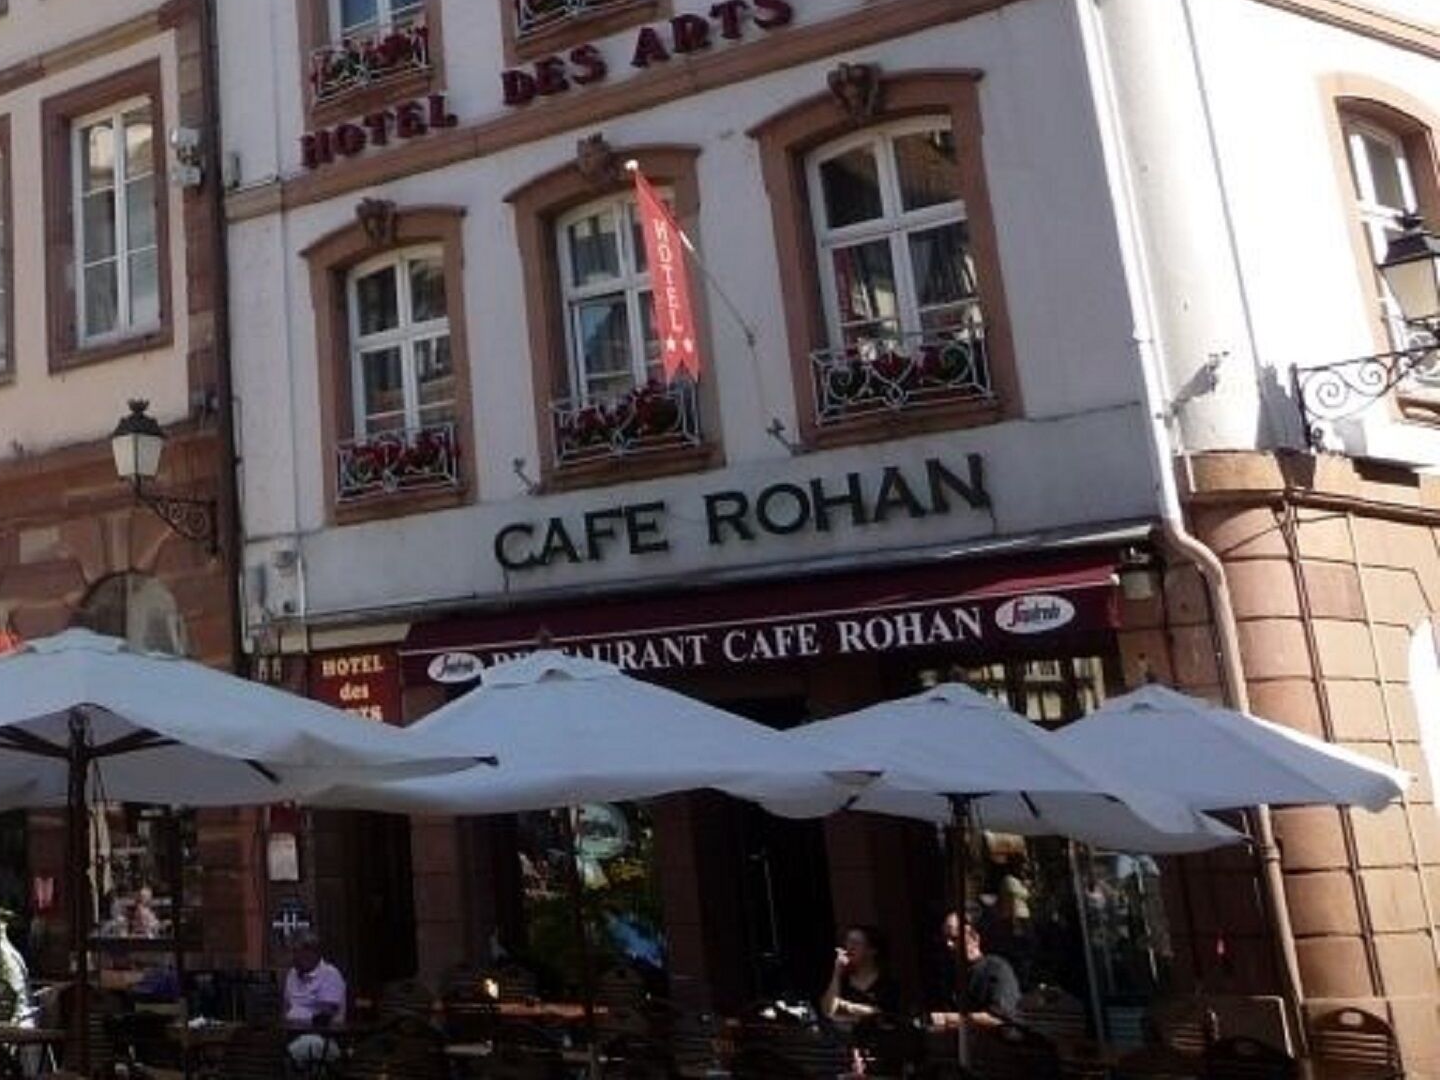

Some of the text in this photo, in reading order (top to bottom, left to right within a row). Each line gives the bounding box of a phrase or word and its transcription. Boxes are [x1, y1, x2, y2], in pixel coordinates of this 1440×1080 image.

[300, 94, 459, 169] HOTEL
[501, 43, 608, 106] DES
[653, 218, 682, 334] HOTEL
[493, 453, 991, 572] CAFE ROHAN
[322, 654, 384, 677] HOTEL
[492, 634, 708, 671] URANT
[722, 623, 820, 663] CAFE
[838, 607, 983, 653] ROHAN
[339, 681, 370, 701] des
